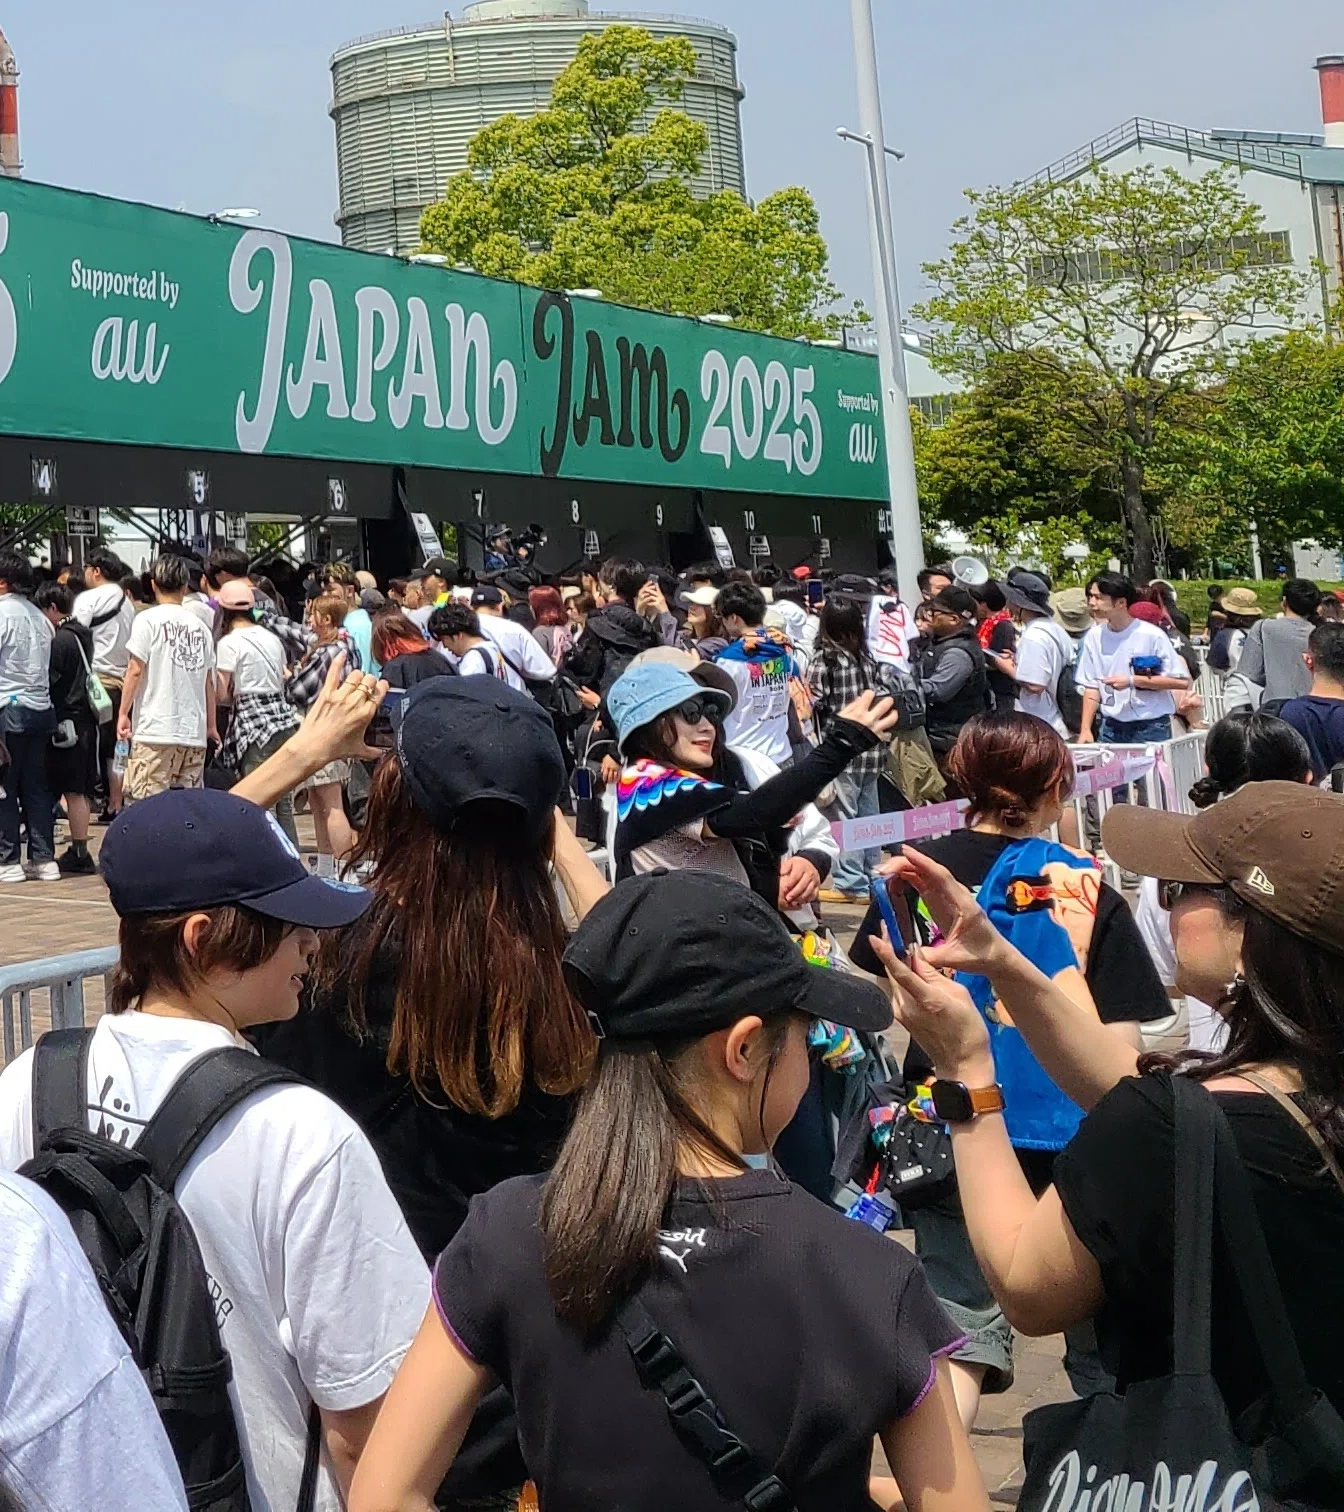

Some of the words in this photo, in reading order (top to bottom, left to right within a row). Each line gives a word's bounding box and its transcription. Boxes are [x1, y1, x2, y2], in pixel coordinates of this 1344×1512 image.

[70, 259, 157, 301] Supported
[159, 272, 180, 309] by
[91, 316, 170, 384] au
[228, 229, 518, 454] JAPAN
[533, 291, 691, 477] JAM
[700, 349, 823, 476] 2025
[837, 389, 870, 413] Supported
[870, 392, 880, 416] by
[849, 422, 878, 464] au
[38, 464, 51, 495] 4
[193, 473, 205, 504] 5
[333, 480, 344, 511] 6
[474, 491, 483, 518] 7
[571, 499, 580, 524] 8
[656, 504, 664, 526] 9
[743, 510, 755, 531] 10
[812, 514, 822, 534] 11
[878, 508, 894, 533] 出口
[762, 672, 785, 688] JAPAN
